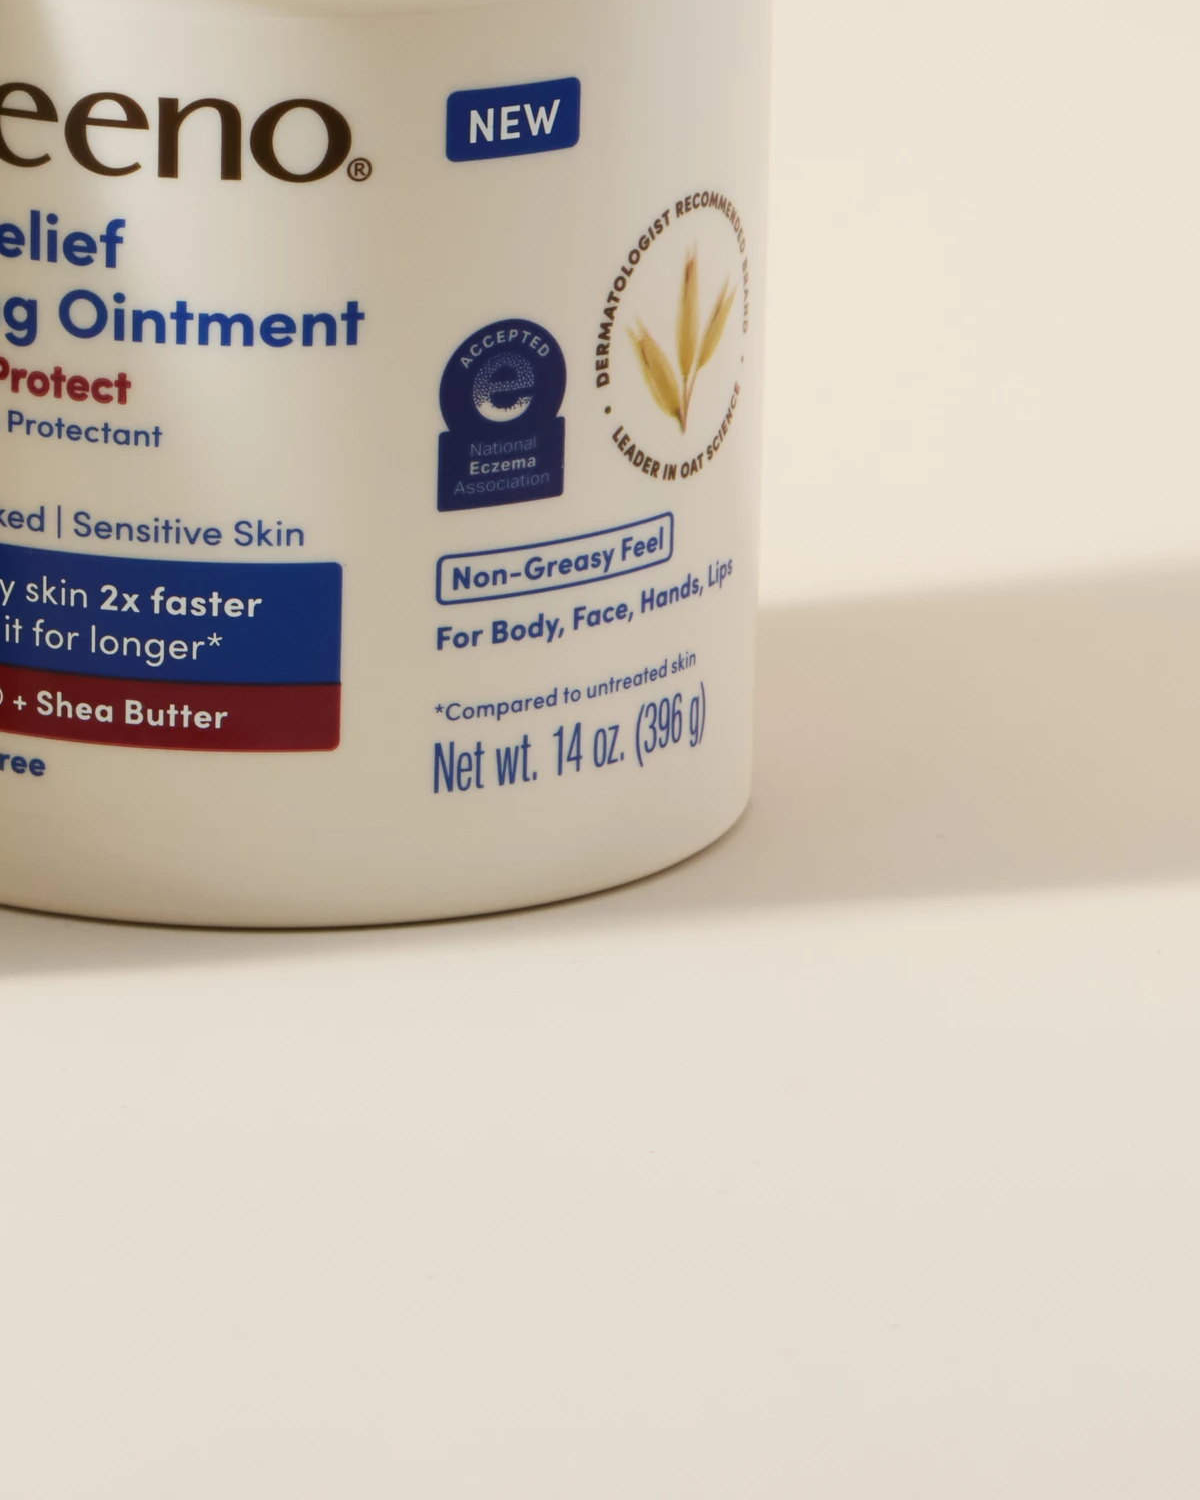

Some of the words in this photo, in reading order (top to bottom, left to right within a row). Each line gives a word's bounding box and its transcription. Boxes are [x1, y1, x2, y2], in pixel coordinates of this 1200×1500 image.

[468, 99, 561, 142] NEW
[596, 208, 672, 390] DERMATOLOGIST
[675, 191, 746, 253] RECOMMENDED
[59, 290, 365, 347] Ointment
[459, 329, 551, 370] ACCEPTED
[8, 411, 163, 449] Protectant
[469, 435, 538, 457] National
[611, 424, 660, 479] LEADER
[662, 460, 677, 482] IN
[679, 452, 705, 480] OAT
[705, 381, 742, 462] SCIENCE
[453, 469, 551, 496] Association
[468, 453, 537, 474] Eczema
[73, 510, 222, 547] Sensitive
[234, 519, 305, 548] Skin
[451, 547, 616, 592] Non-Greasy
[621, 526, 665, 562] Feel
[25, 577, 89, 610] skin
[100, 584, 141, 614] 2x
[150, 586, 263, 619] faster
[436, 625, 483, 652] For
[490, 613, 566, 649] Body,
[572, 601, 634, 631] Face,
[639, 573, 704, 614] Hands,
[707, 558, 733, 590] Lips
[3, 613, 23, 645] it
[32, 618, 81, 652] for
[562, 684, 582, 705] to
[585, 659, 668, 701] untreated
[671, 649, 697, 679] skin
[13, 695, 28, 711] +
[36, 690, 116, 727] Shea
[125, 699, 228, 731] Butter
[433, 740, 484, 794] Net
[496, 735, 539, 787] wt.
[552, 721, 584, 776] 14
[593, 725, 625, 769] oz.
[634, 691, 685, 768] (396
[688, 681, 706, 746] g)
